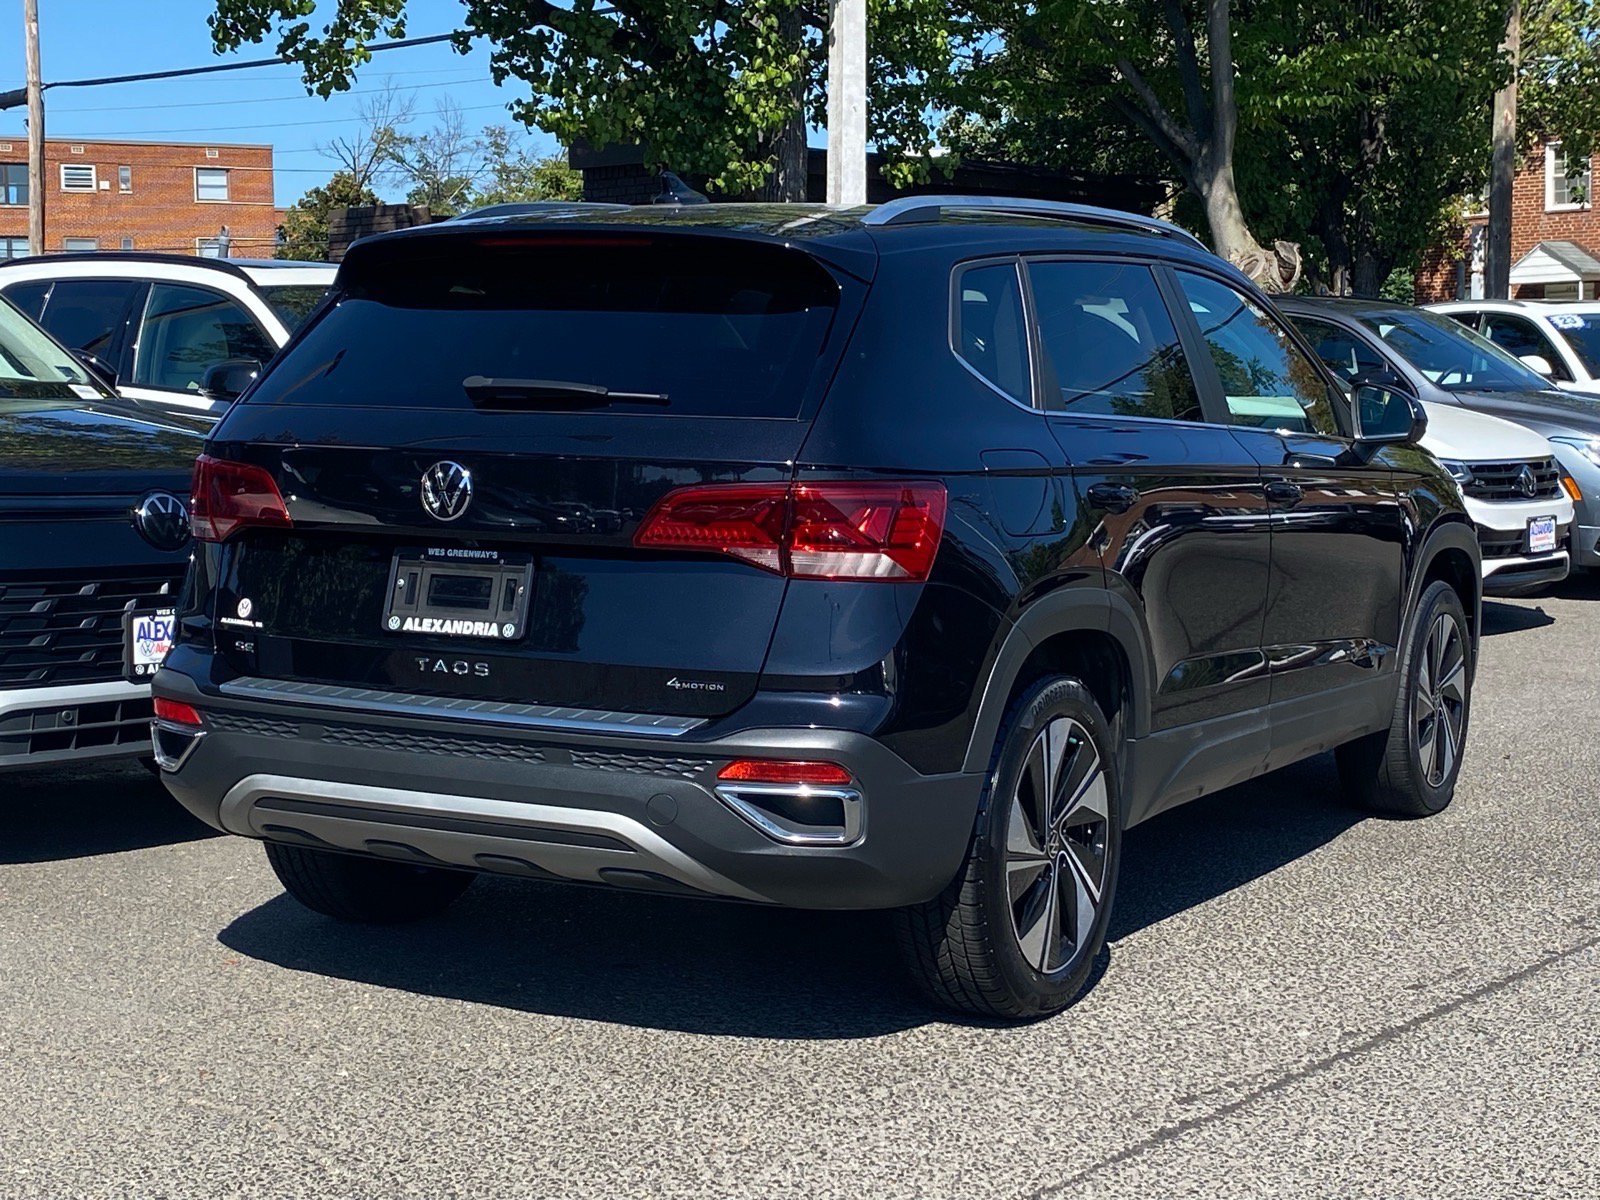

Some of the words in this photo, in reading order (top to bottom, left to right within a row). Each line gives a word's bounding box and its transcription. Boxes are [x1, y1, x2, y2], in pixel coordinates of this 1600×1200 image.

[428, 547, 446, 556] WES
[447, 549, 498, 559] GREENWAY'S
[136, 620, 173, 643] ALEX
[402, 616, 499, 637] ALEXANDRIA
[415, 656, 490, 677] TAOS
[666, 677, 725, 691] 4MOTION
